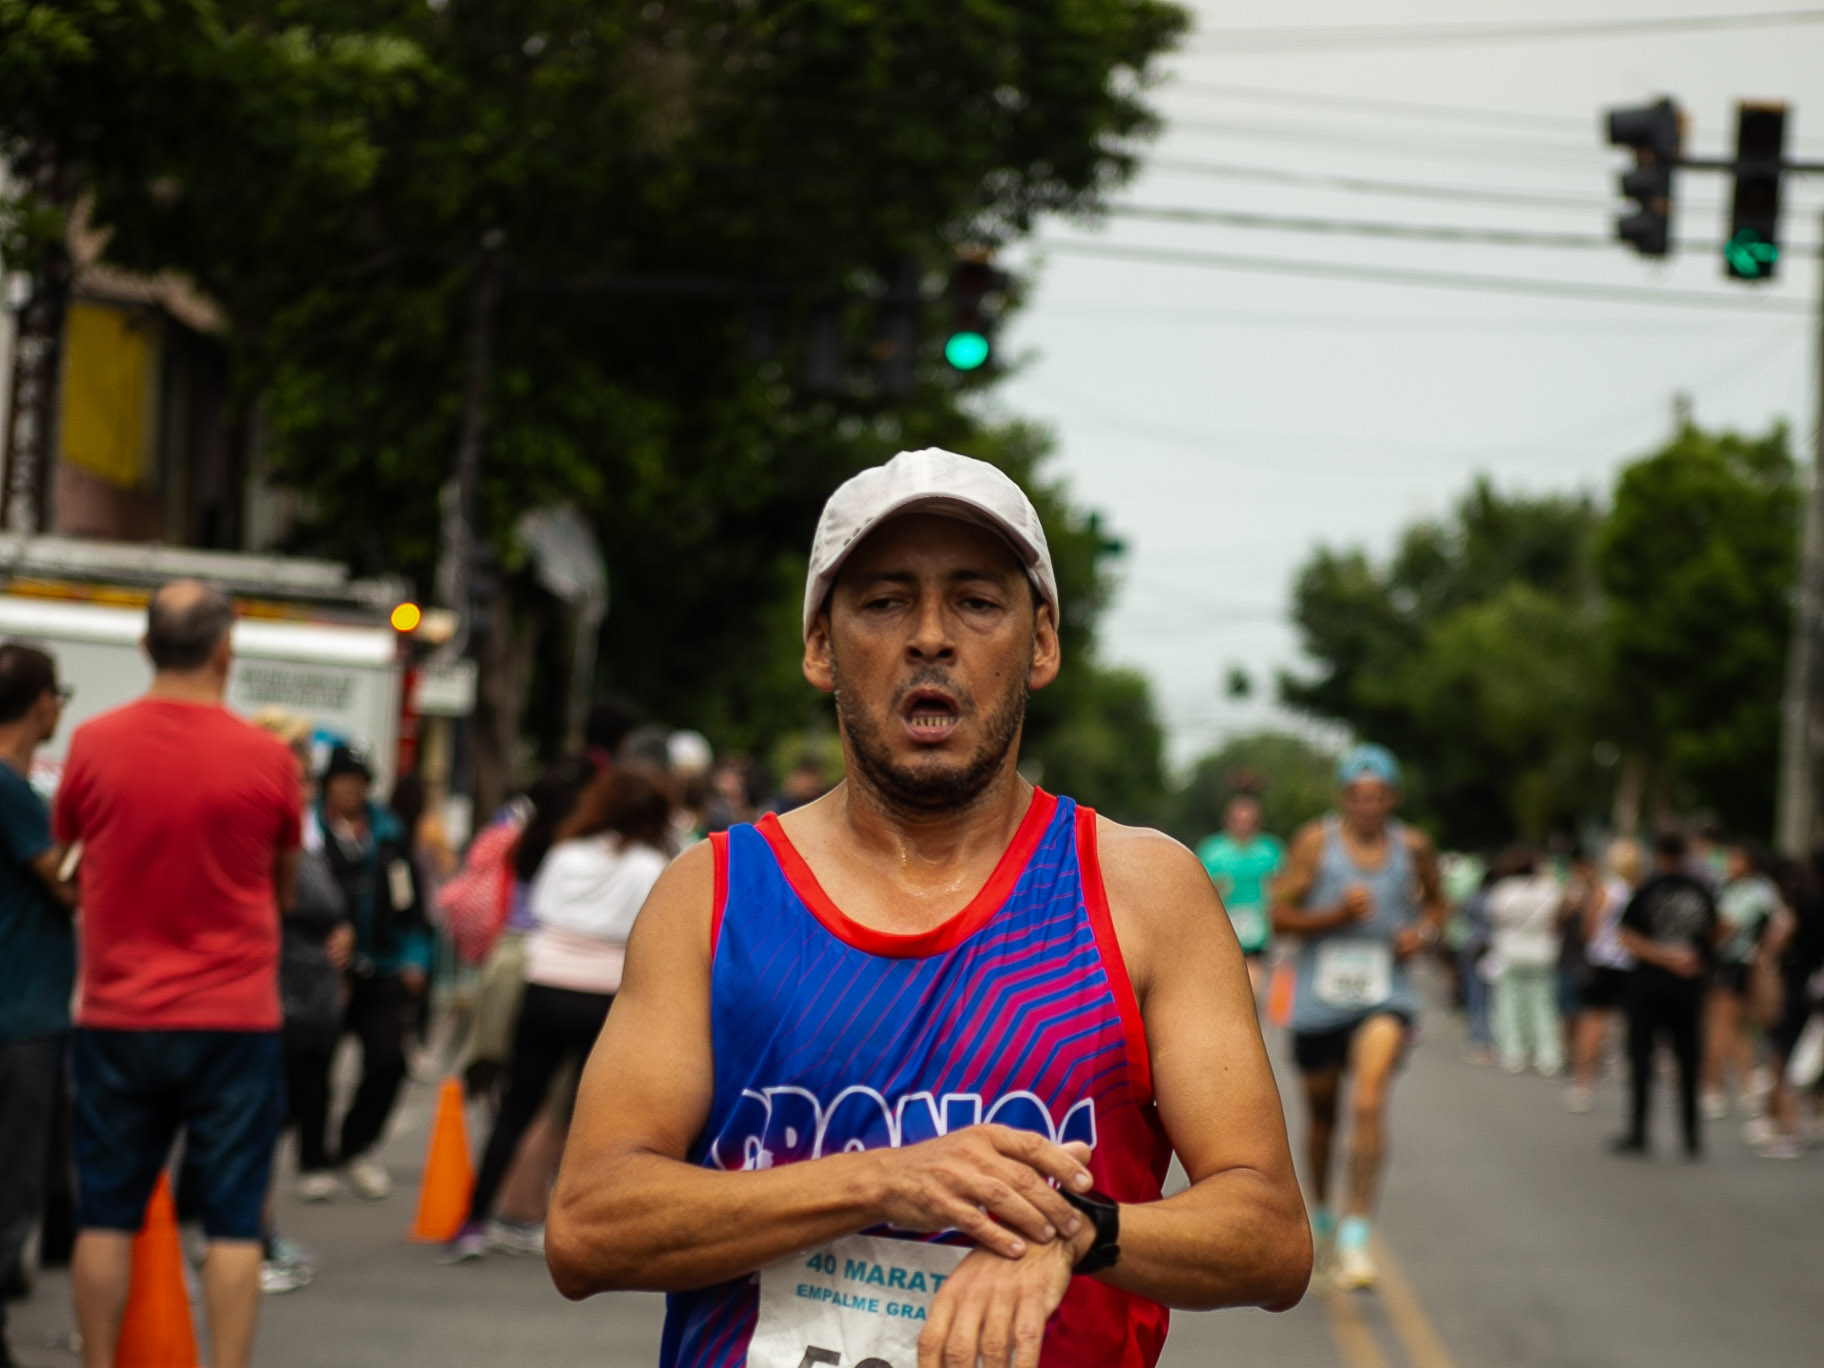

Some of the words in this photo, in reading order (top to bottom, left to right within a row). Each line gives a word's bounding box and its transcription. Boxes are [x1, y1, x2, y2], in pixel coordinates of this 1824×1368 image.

[806, 1253, 837, 1276] 40
[843, 1259, 949, 1295] MARAT
[796, 1283, 880, 1313] EMPALME
[886, 1301, 927, 1321] GRA
